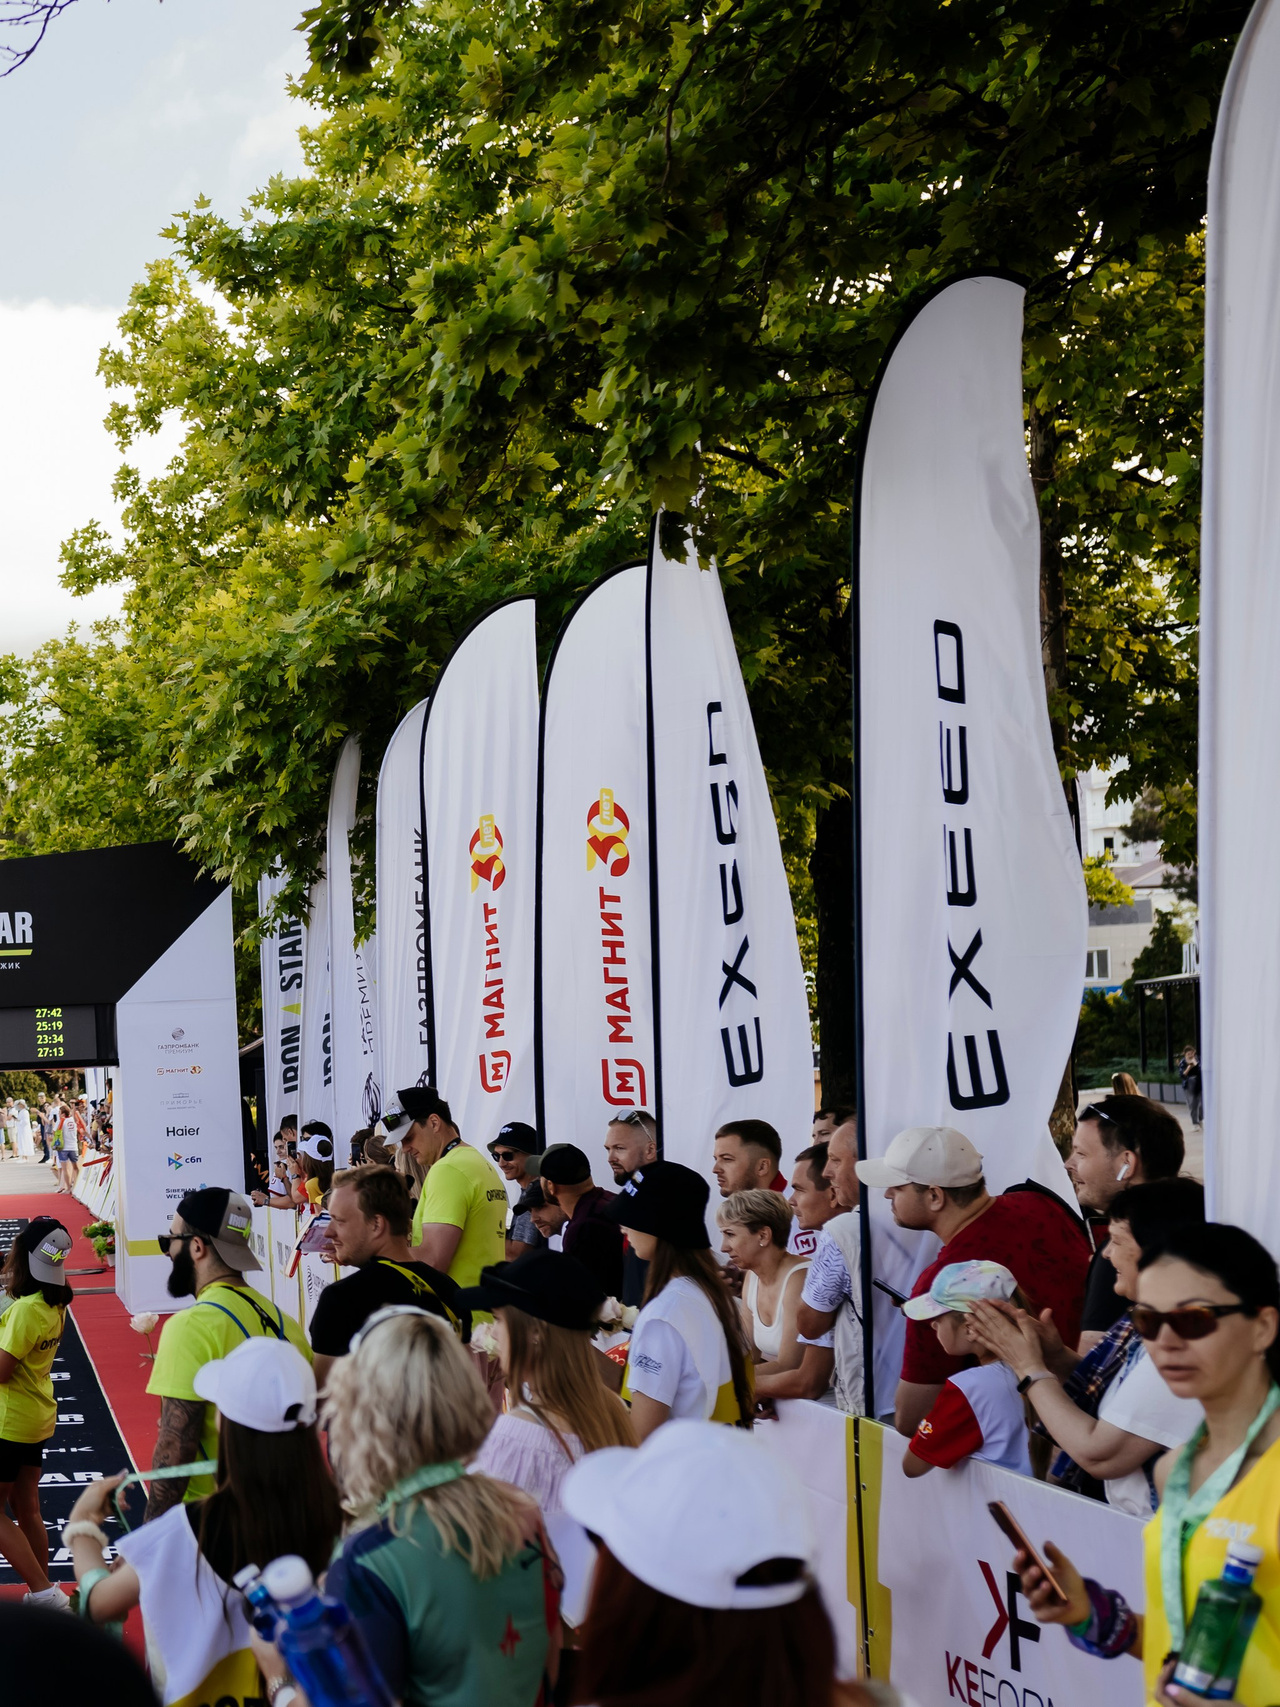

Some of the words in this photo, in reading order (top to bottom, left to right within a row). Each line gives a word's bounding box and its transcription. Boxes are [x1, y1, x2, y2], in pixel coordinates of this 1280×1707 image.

[933, 619, 1011, 1111] EXEED
[599, 886, 634, 1043] МАГНИТ
[482, 902, 506, 1039] МАГНИТ
[35, 1008, 63, 1018] 27:42
[36, 1021, 64, 1031] 25:19
[36, 1034, 64, 1045] 23:34
[157, 1042, 200, 1050] ГАЗПРОМБАНК
[37, 1047, 65, 1058] 27:13
[166, 1125, 200, 1137] Haier
[184, 1155, 202, 1164] сбп
